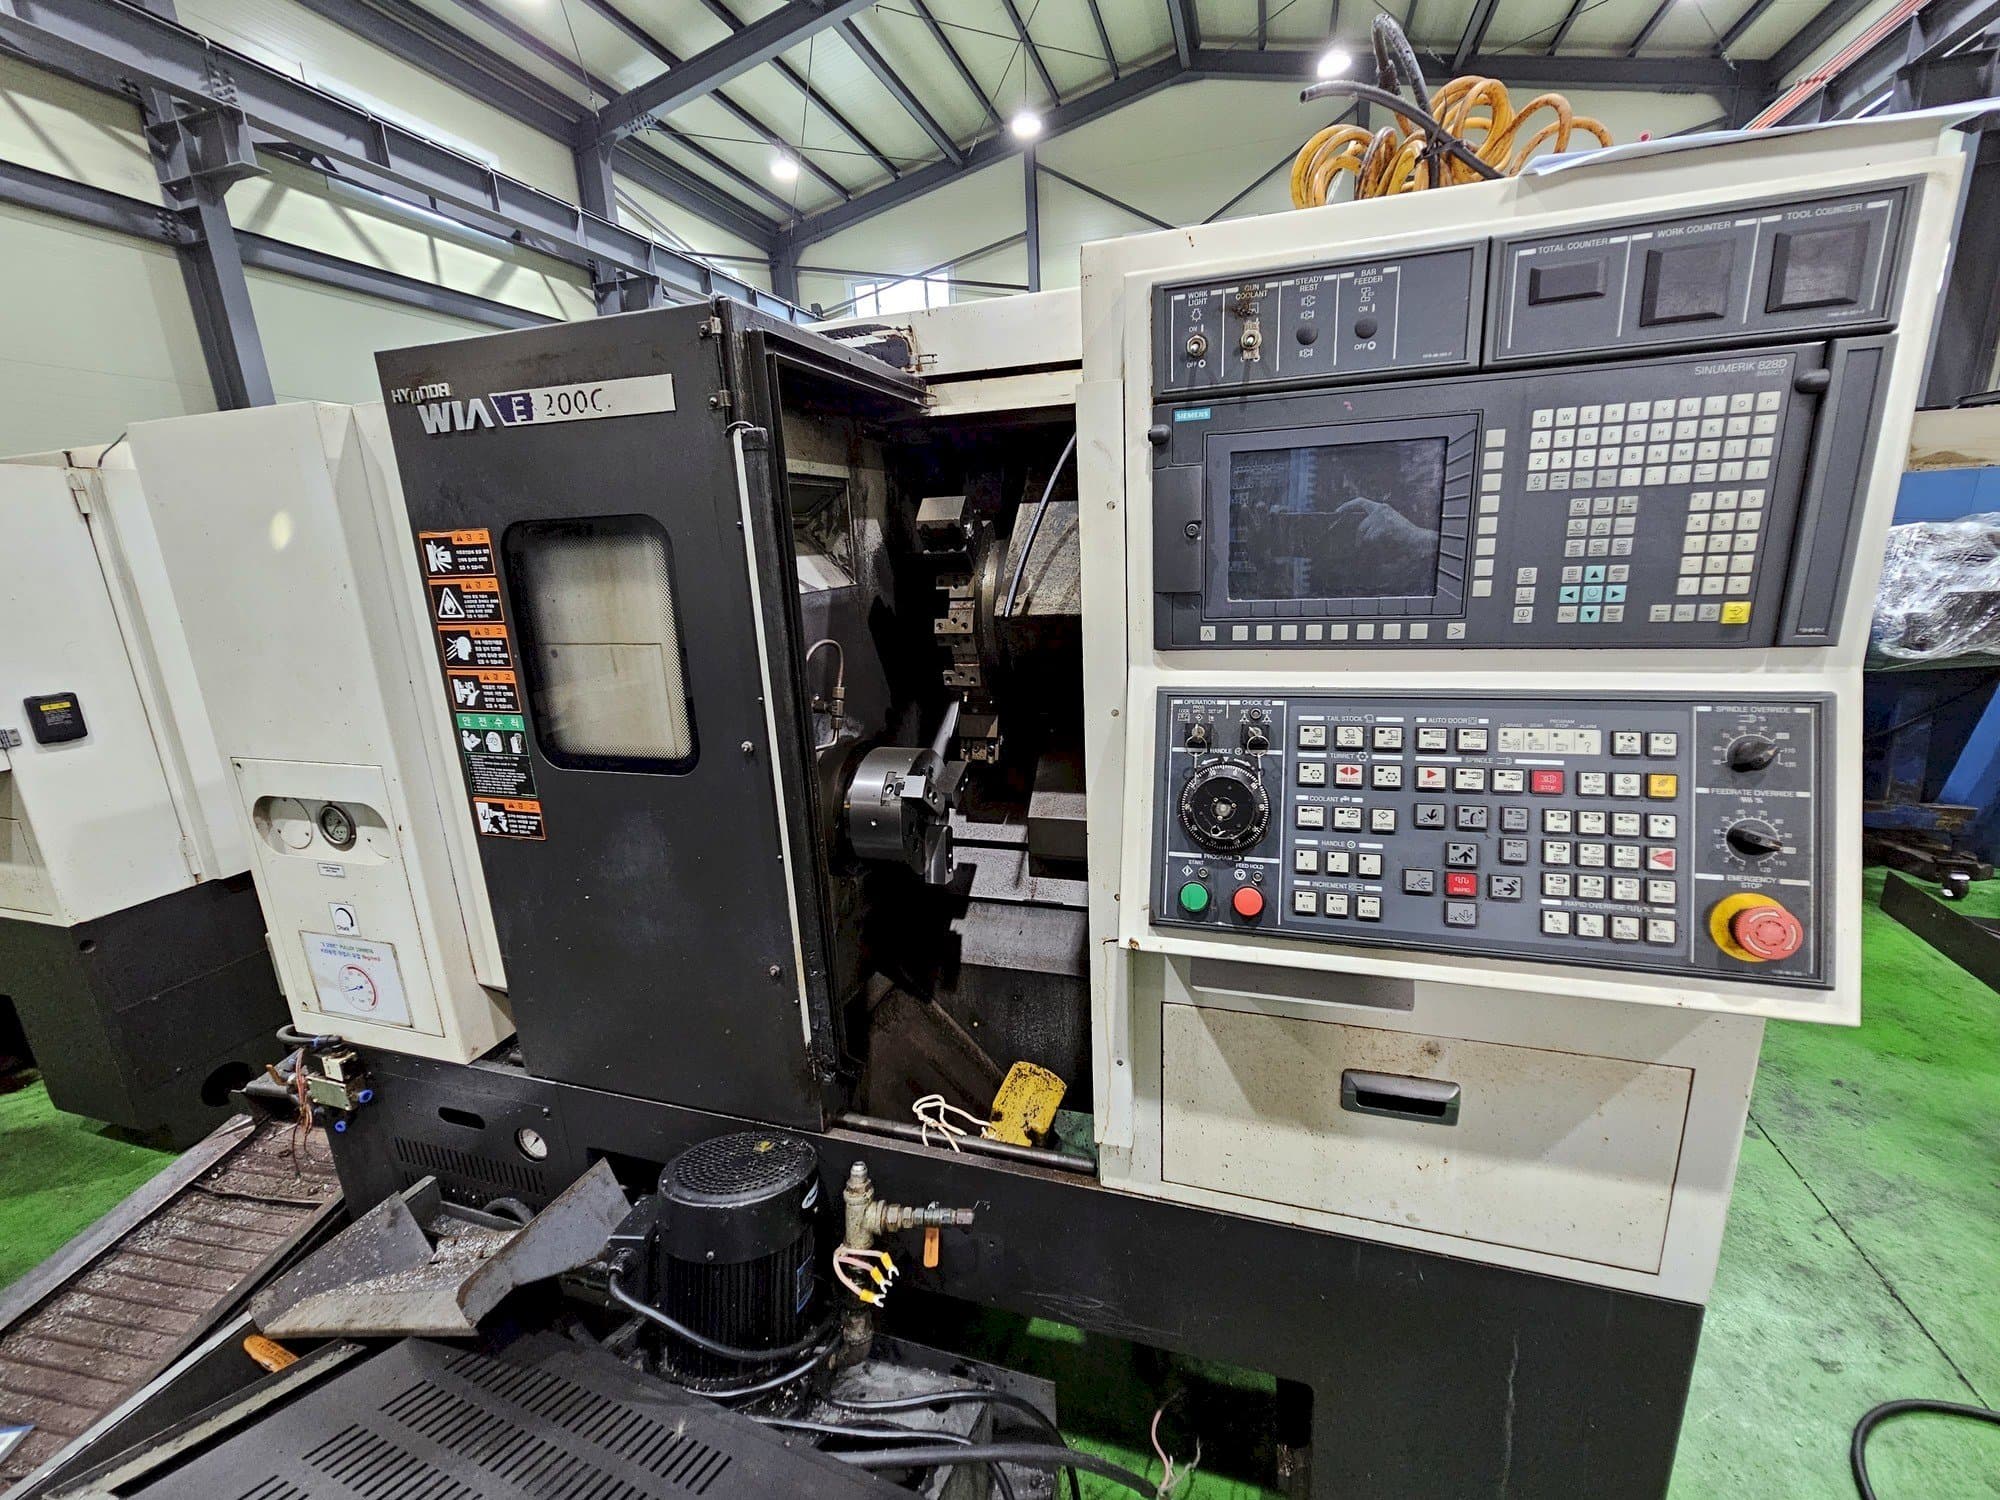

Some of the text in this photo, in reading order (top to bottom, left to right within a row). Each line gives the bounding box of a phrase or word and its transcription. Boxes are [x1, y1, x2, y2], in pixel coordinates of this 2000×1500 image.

[1787, 210, 1813, 220] TOOL
[1657, 220, 1731, 238] WORK COUNTER
[1538, 238, 1609, 254] TOTAL COUNTER
[1361, 268, 1377, 277] BAR
[1296, 276, 1324, 286] STEADY
[1354, 275, 1383, 286] FEEDER
[1300, 283, 1319, 292] REST
[1188, 290, 1208, 299] WORK
[1236, 290, 1268, 300] COOLANT
[1188, 298, 1208, 306] LIGHT
[1695, 359, 1788, 376] SINUMERIK 828D
[418, 398, 495, 435] WIA
[1711, 788, 1752, 796] FEEDRATE
[1727, 875, 1777, 884] EMERGENCY
